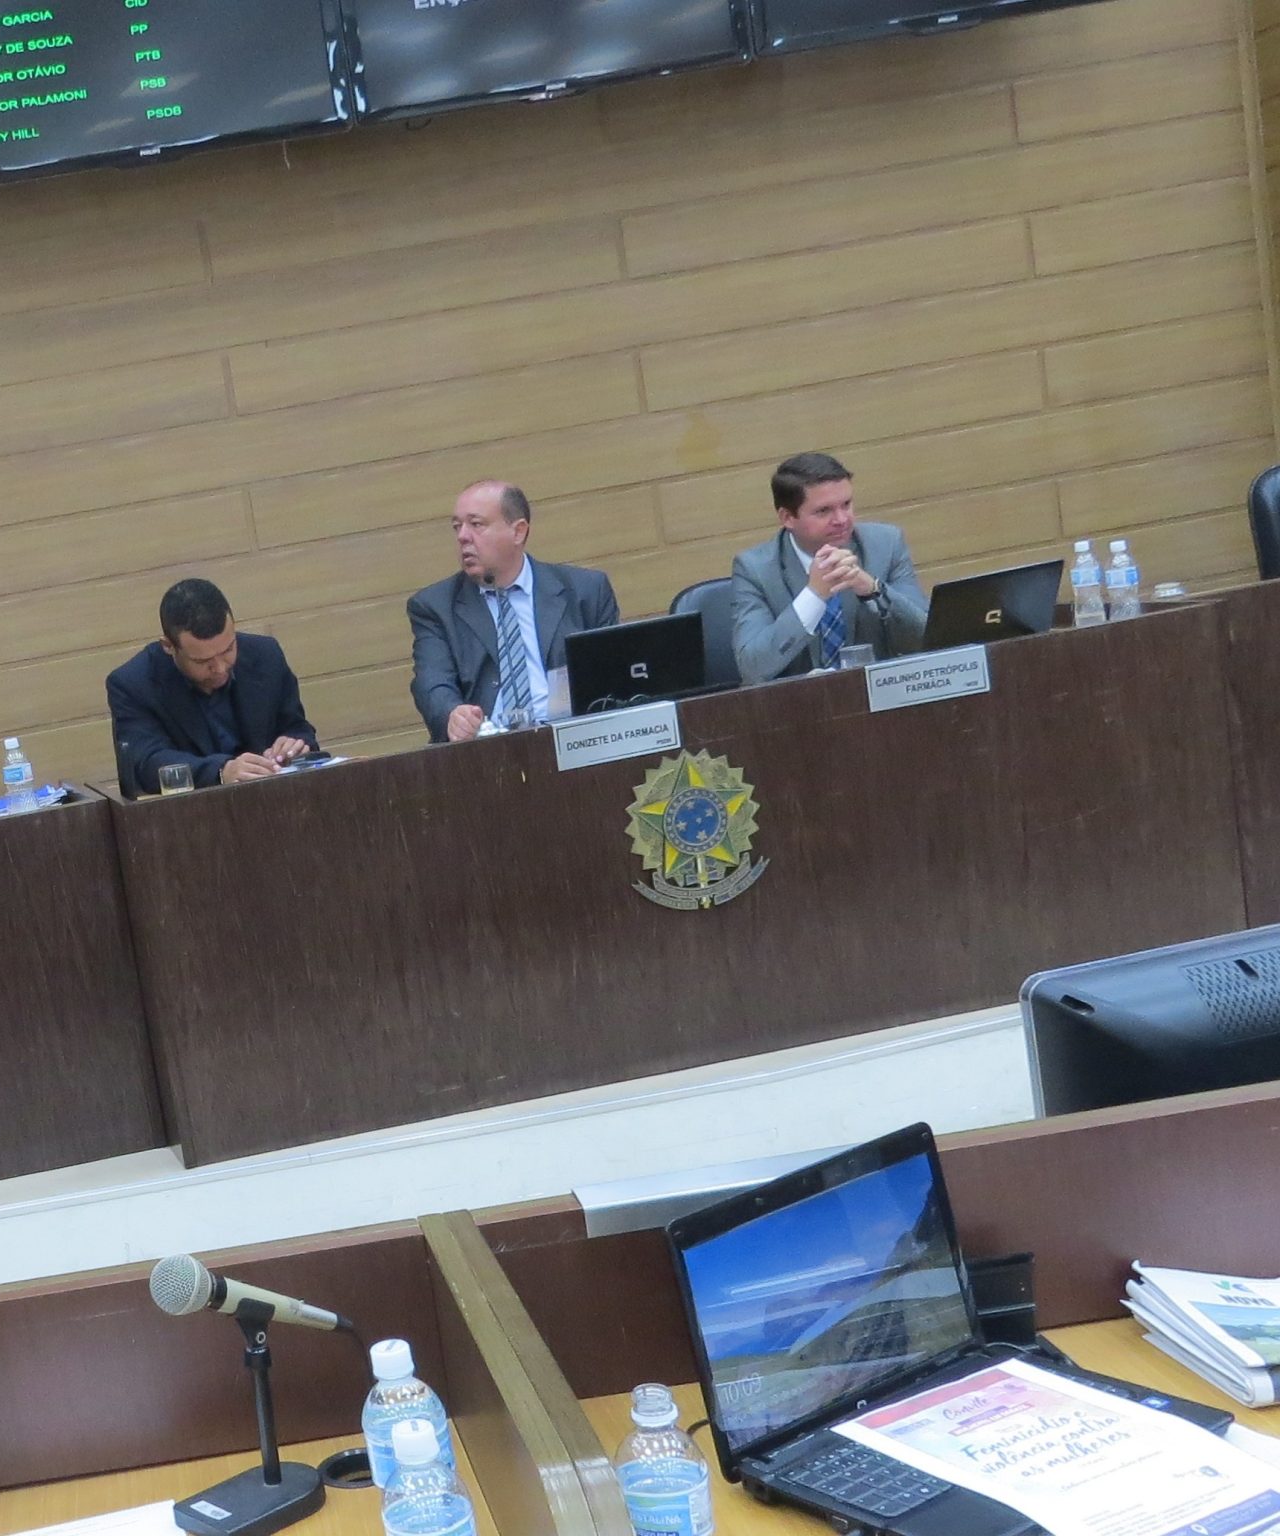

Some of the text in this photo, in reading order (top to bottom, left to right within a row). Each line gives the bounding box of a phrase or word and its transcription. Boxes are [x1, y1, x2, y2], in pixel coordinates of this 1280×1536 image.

[2, 10, 53, 26] GARCIA
[130, 24, 148, 35] PP
[6, 42, 25, 54] DE
[27, 35, 73, 51] SOUZA
[135, 50, 161, 62] PTB
[16, 64, 66, 81] OTÁVIO
[140, 77, 166, 90] PSB
[21, 89, 88, 108] PALAMONI
[146, 105, 182, 119] PSDB
[12, 128, 40, 141] HILL
[876, 661, 978, 687] CARLINHO PETRÓPOLIS
[905, 678, 952, 694] FARMÁCIA
[567, 735, 609, 751] DONIZETE
[611, 732, 623, 743] DA
[1061, 1416, 1120, 1442] contra
[1021, 1466, 1046, 1477] as
[1047, 1431, 1131, 1467] mulheres
